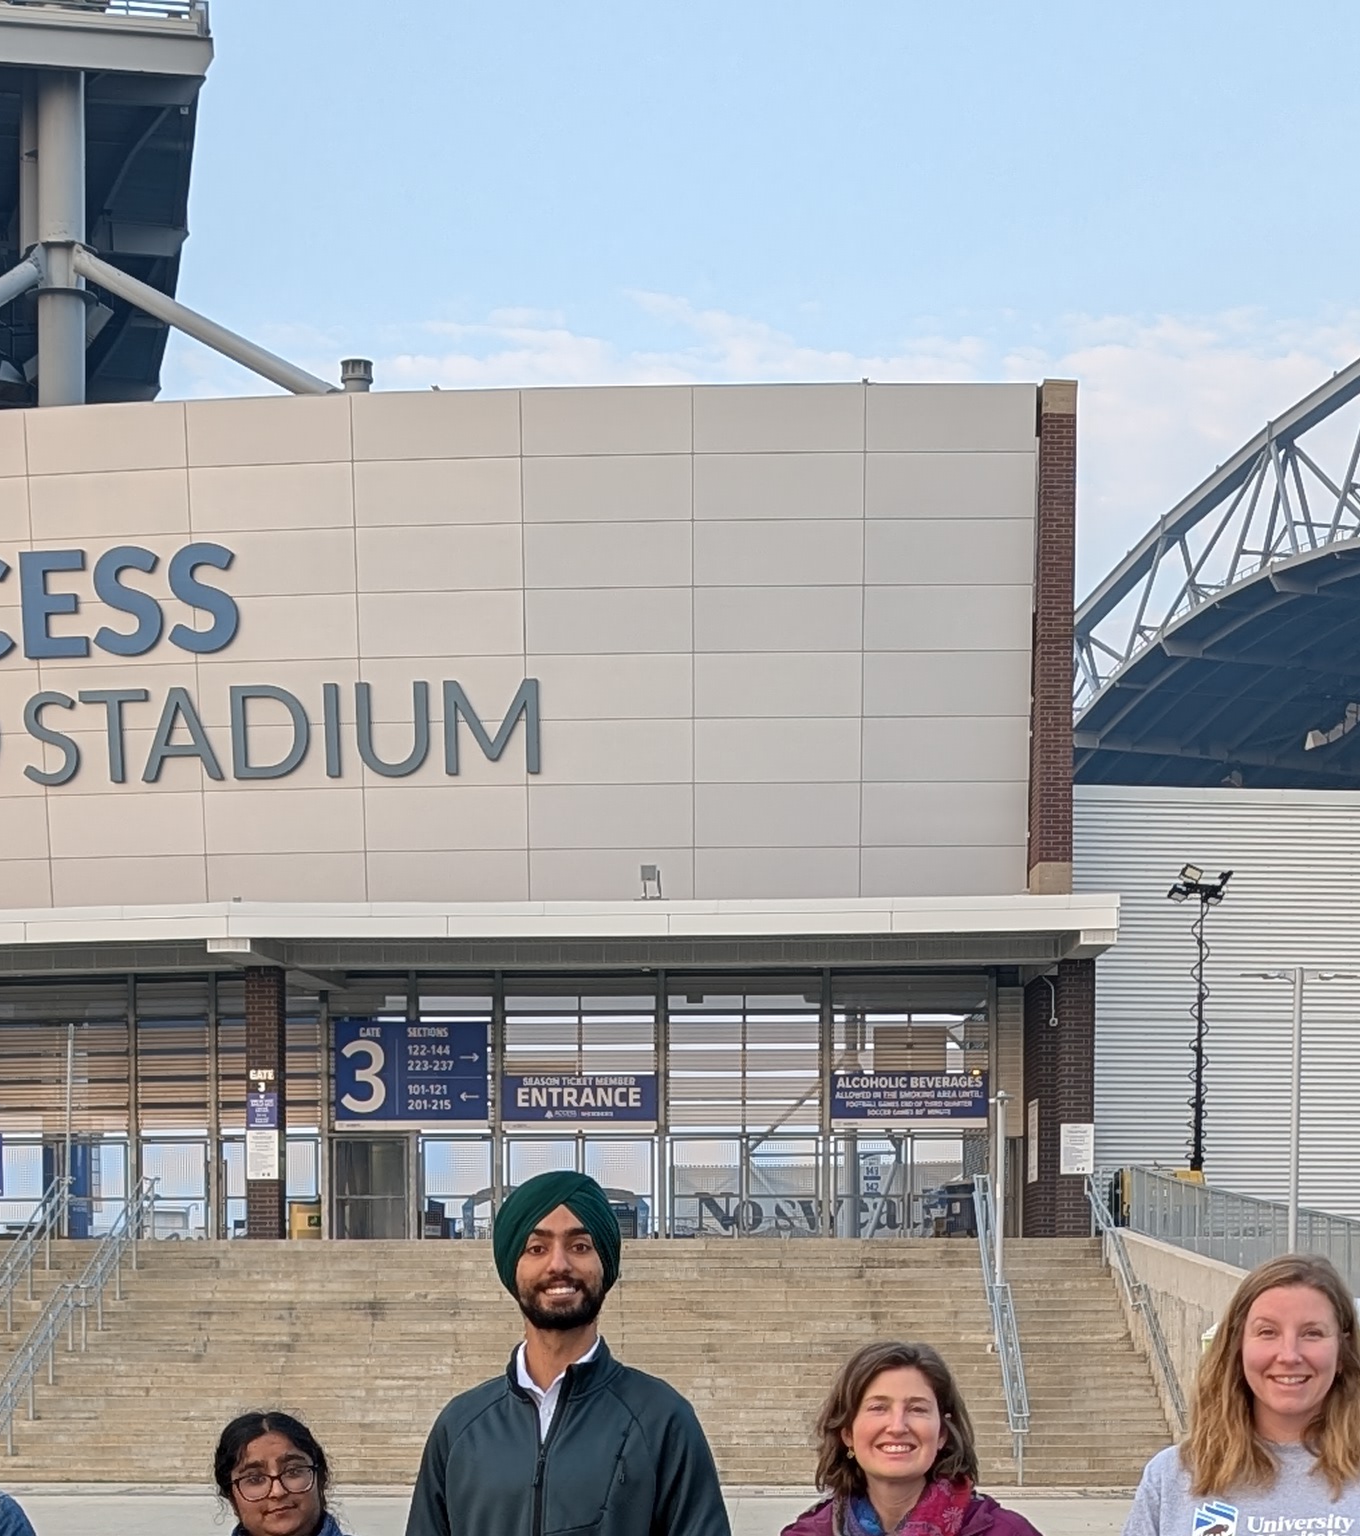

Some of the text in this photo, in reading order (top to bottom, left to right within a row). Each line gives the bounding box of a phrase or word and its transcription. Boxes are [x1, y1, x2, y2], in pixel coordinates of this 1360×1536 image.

[23, 678, 540, 786] STADIUM
[359, 1027, 448, 1038] GATE SECTIONS
[407, 1045, 450, 1056] 122-144
[407, 1061, 454, 1071] 223-237
[249, 1069, 275, 1081] GATE
[341, 1039, 386, 1113] 3
[523, 1077, 636, 1086] SEASON TICKET MEMBER
[836, 1076, 984, 1089] ALCOHOLIC BEVERAGES
[257, 1082, 266, 1093] 3
[407, 1084, 448, 1095] 101-121
[517, 1087, 642, 1107] ENTRANCE
[835, 1091, 872, 1100] ALLOWED
[407, 1100, 451, 1111] 201-215
[1247, 1513, 1355, 1533] University
